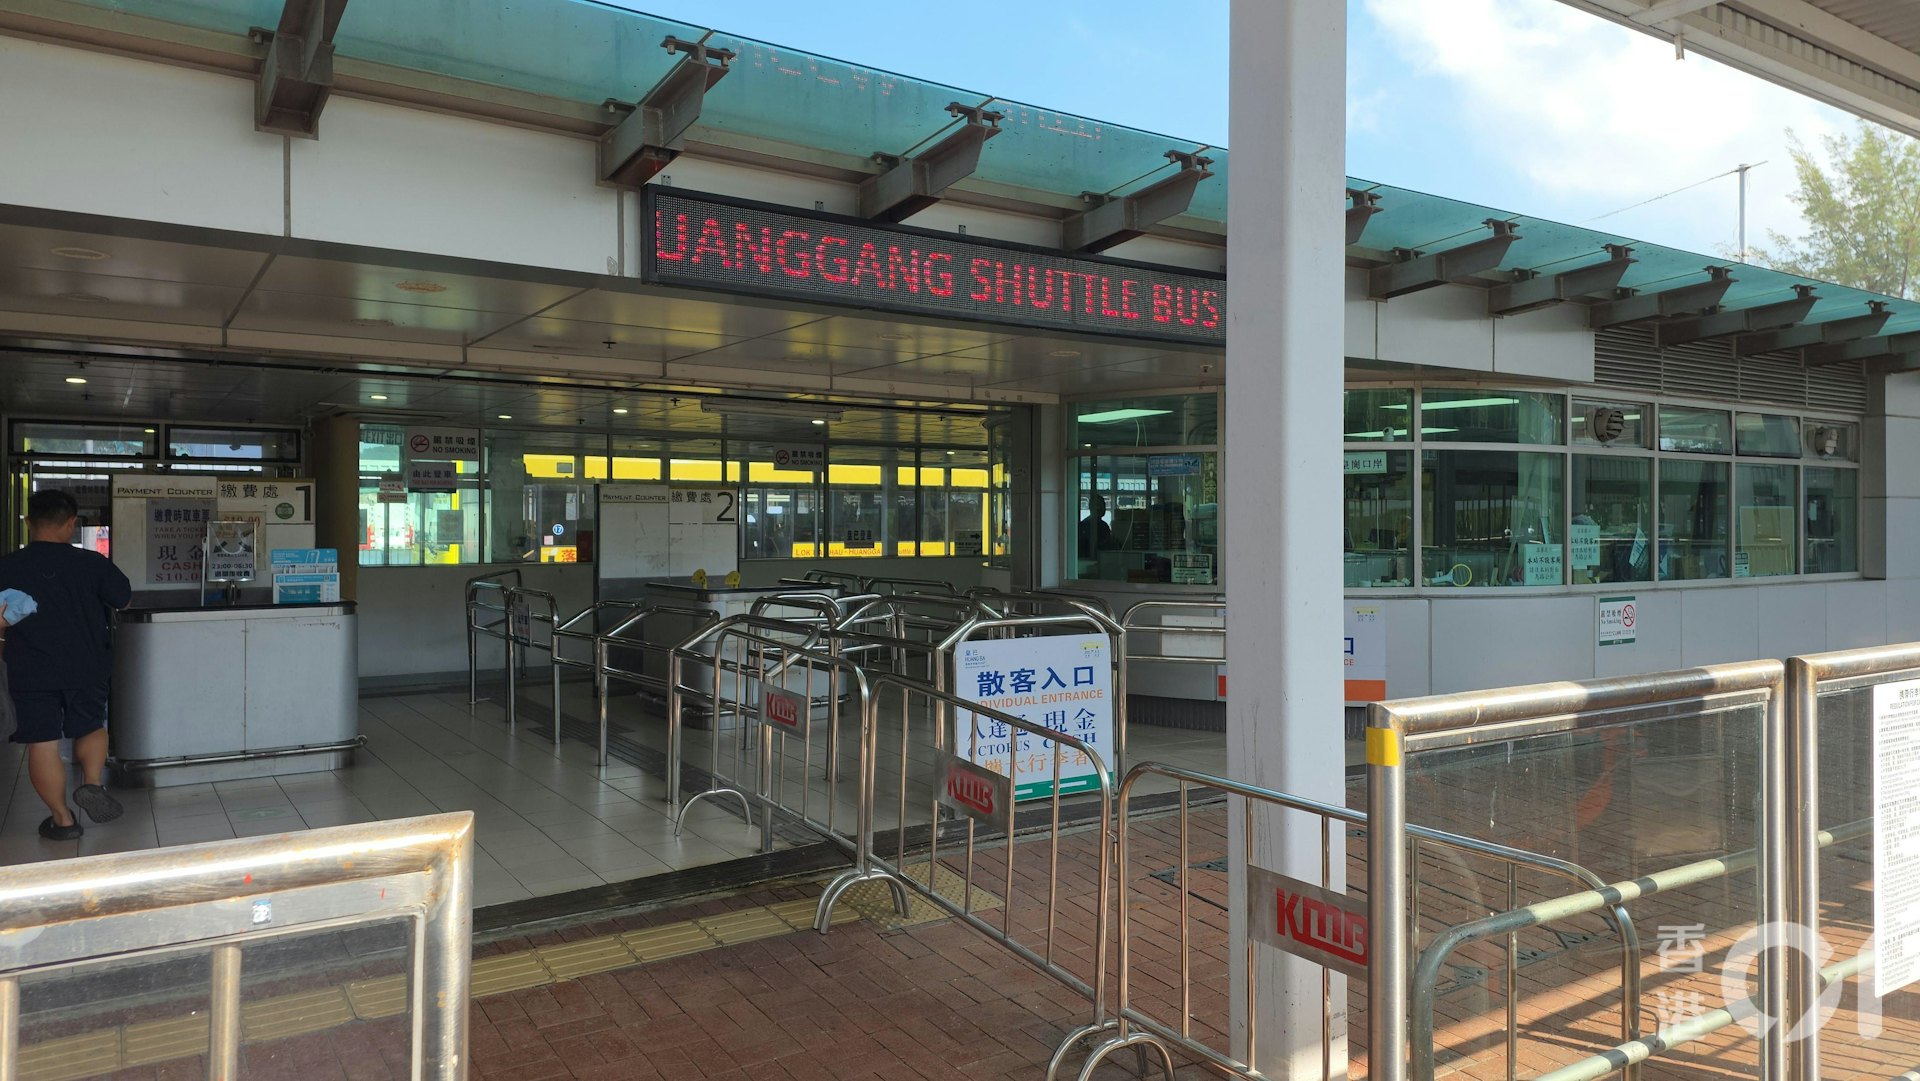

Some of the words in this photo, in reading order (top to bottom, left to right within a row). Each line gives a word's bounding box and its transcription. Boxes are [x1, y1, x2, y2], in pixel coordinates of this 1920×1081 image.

[970, 257, 1139, 319] SHUTTLE
[1153, 284, 1219, 327] BUS
[167, 488, 213, 496] COUNTER
[220, 484, 279, 499] 繳費處
[671, 491, 713, 503] 繳費處
[295, 485, 311, 521] 1
[716, 491, 735, 522] 2
[554, 525, 563, 534] 17
[161, 562, 202, 571] CASH
[977, 665, 1095, 698] 散客入口
[978, 695, 1038, 710] DIVIDUAL
[1041, 689, 1103, 704] ENTRANCE
[1042, 708, 1096, 733] 現金
[1042, 732, 1097, 749] CH
[1276, 887, 1368, 967] KMB
